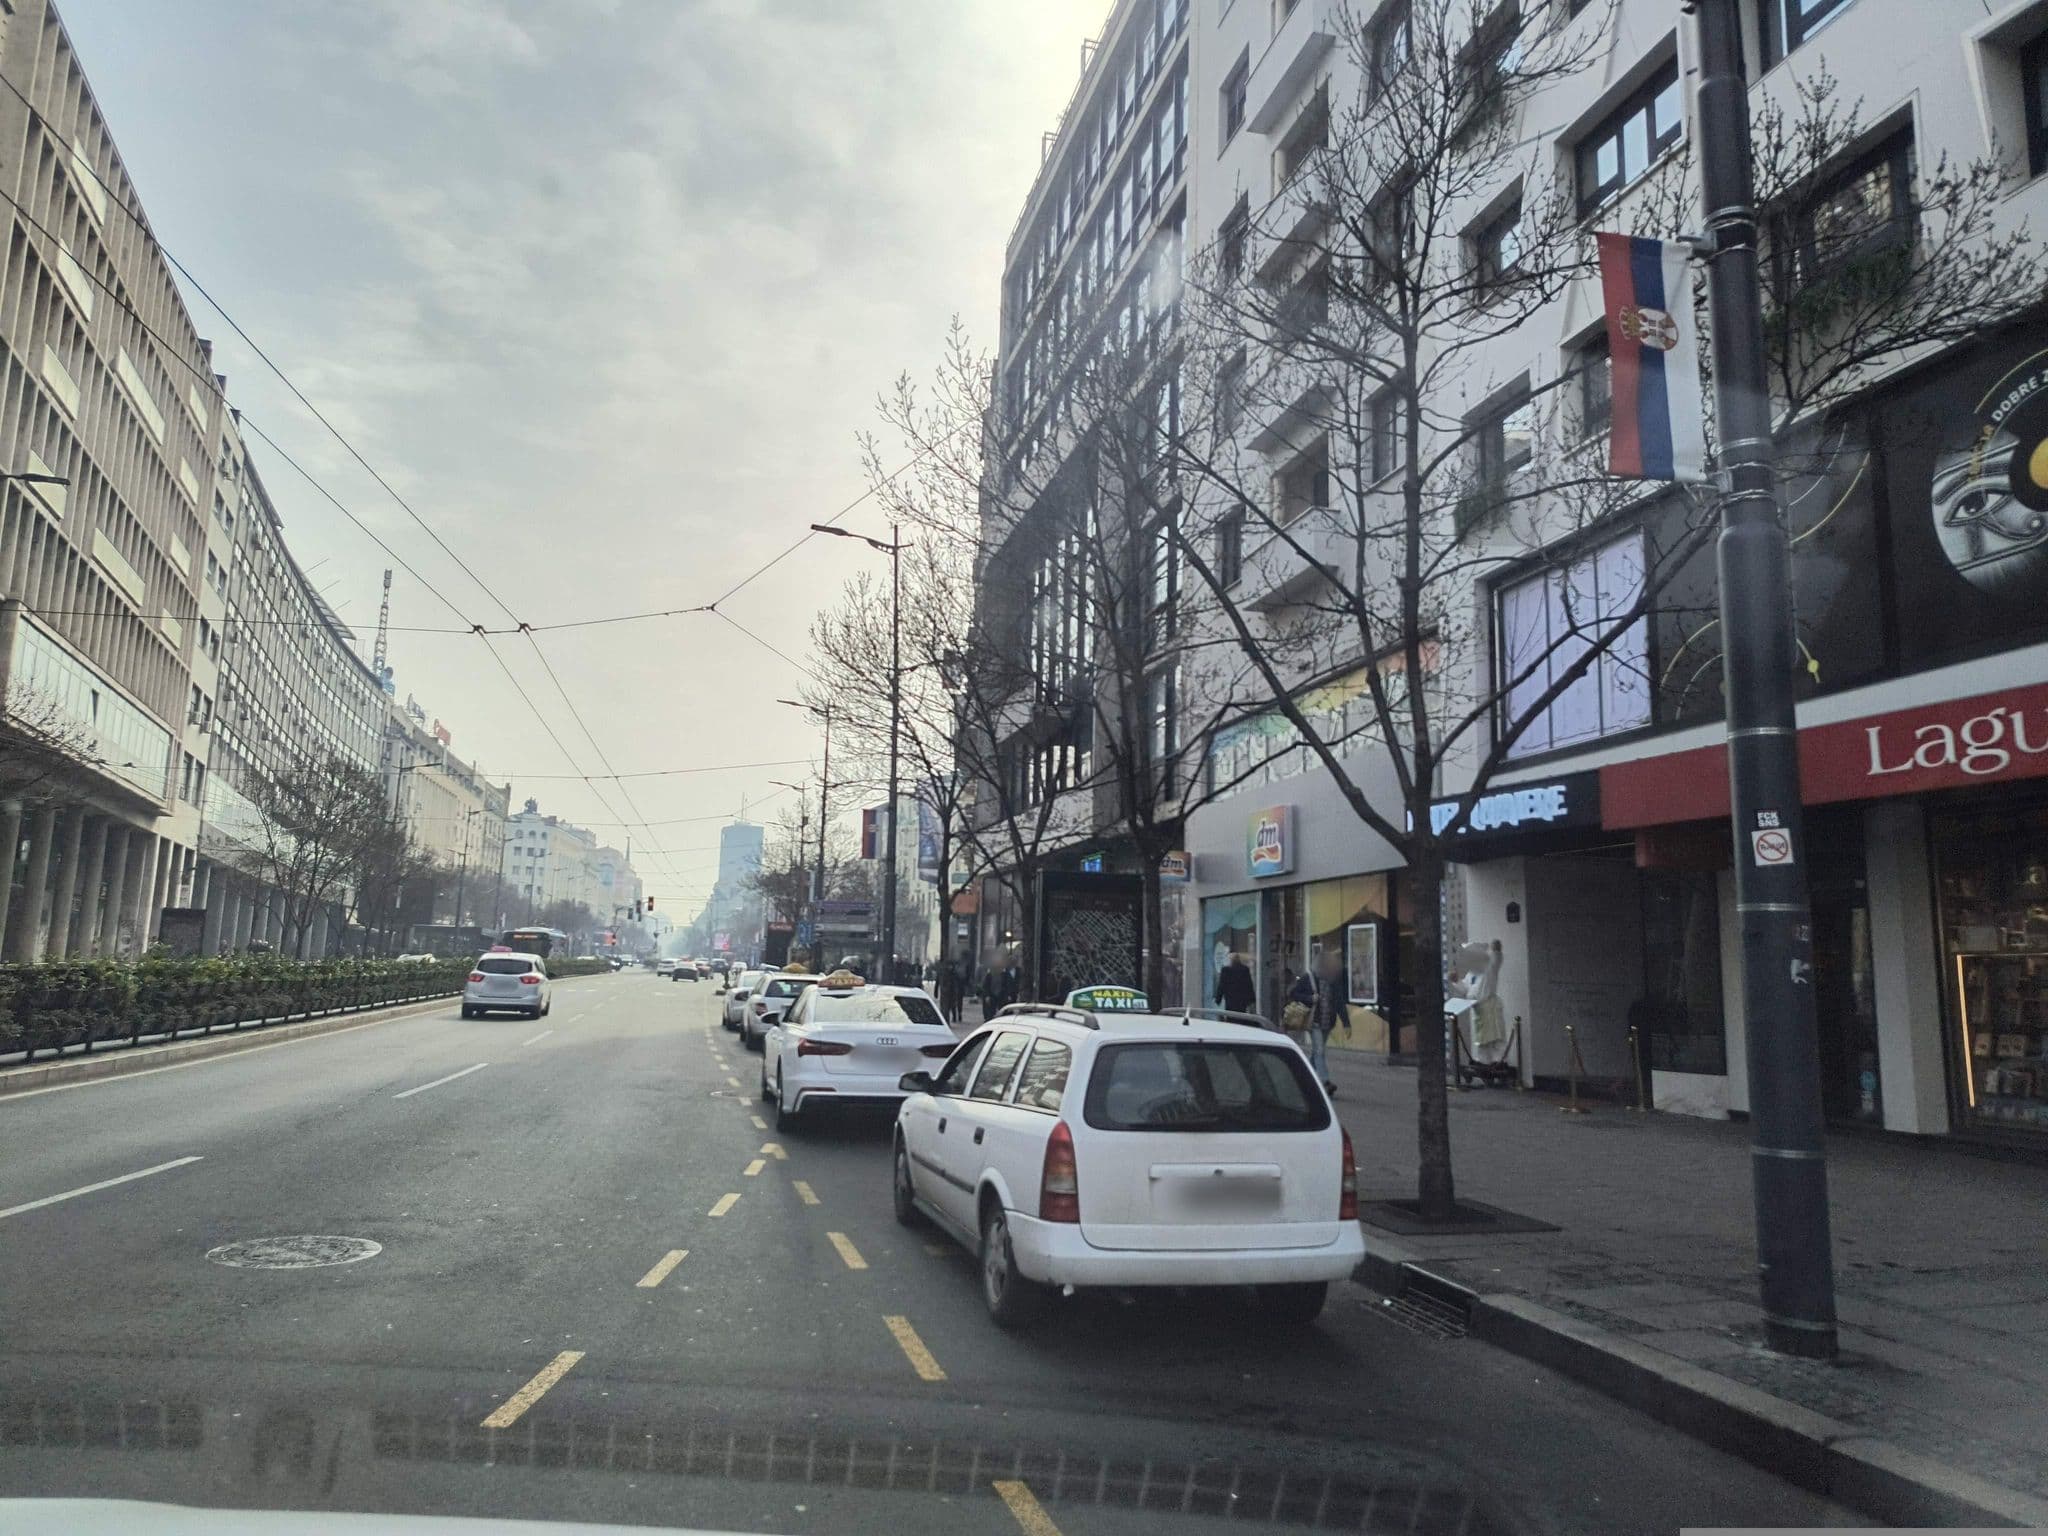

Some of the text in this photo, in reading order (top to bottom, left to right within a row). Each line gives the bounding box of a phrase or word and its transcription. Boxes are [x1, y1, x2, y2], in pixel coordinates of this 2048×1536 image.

[1991, 376, 2039, 421] DOBRE
[1256, 820, 1277, 848] dm
[1094, 998, 1132, 1008] TAXI
